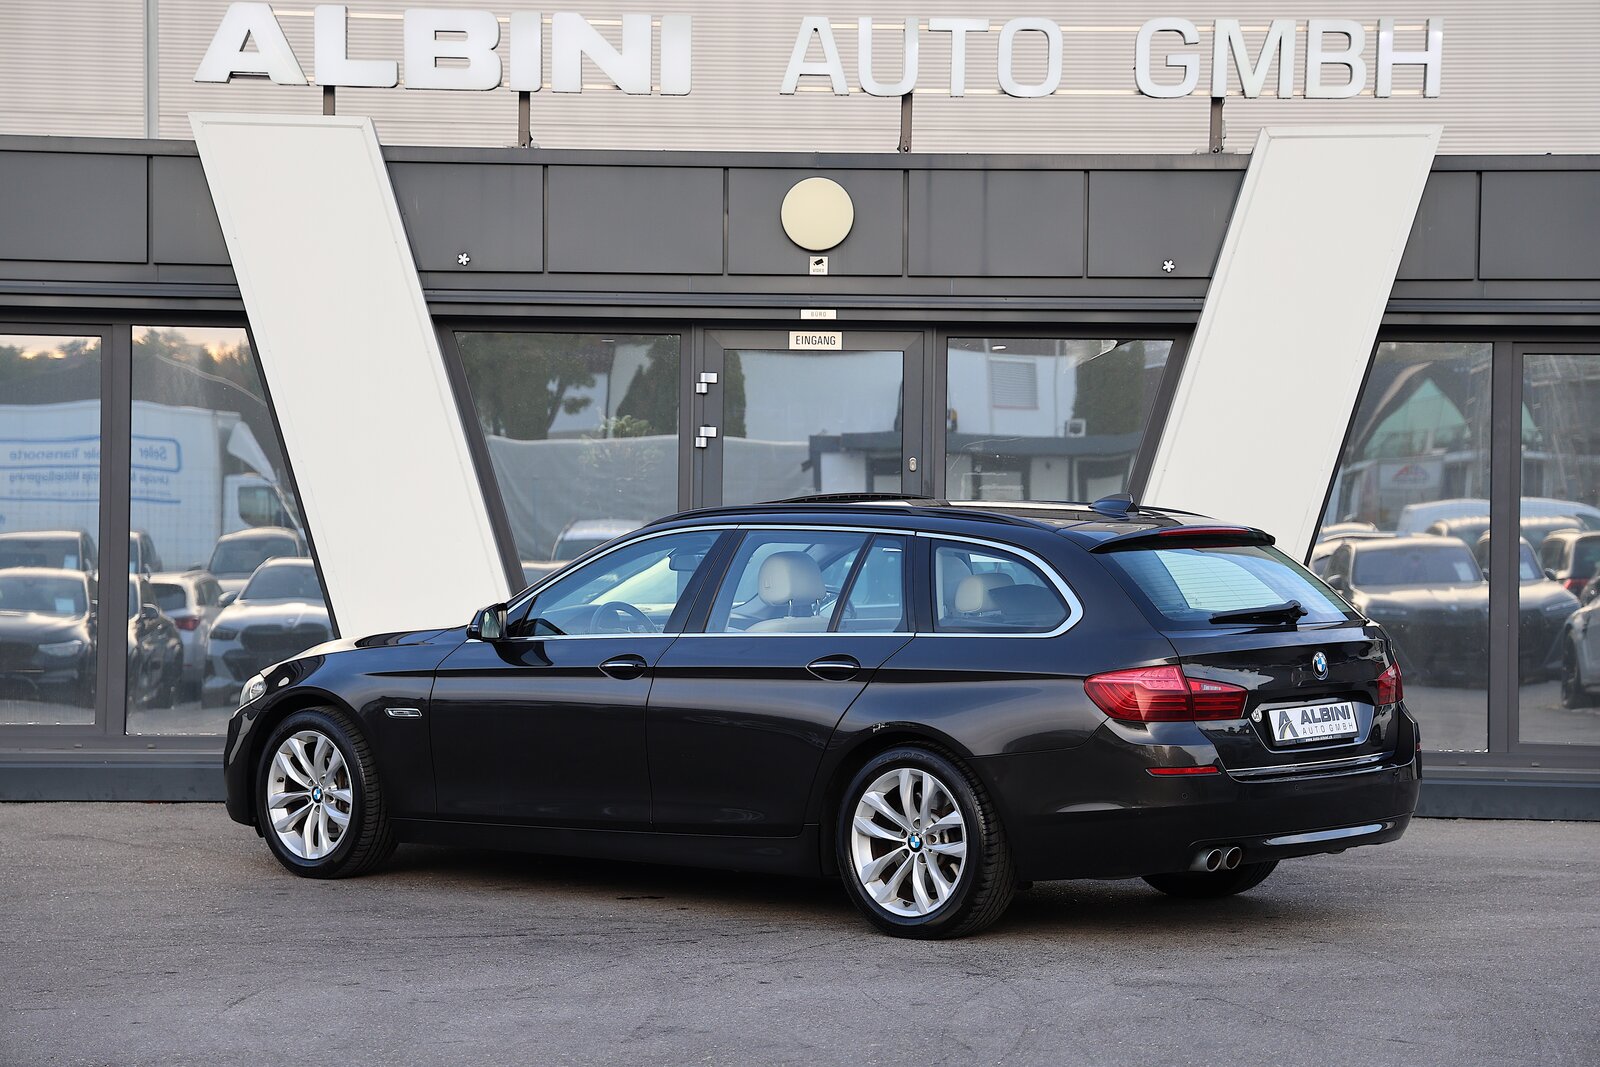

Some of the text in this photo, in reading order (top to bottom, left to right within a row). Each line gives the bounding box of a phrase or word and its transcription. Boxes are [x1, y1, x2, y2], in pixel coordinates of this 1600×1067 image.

[194, 2, 1444, 99] ALBINI AUTO GMBH
[795, 335, 836, 346] EINGANG
[1301, 705, 1351, 725] ALBINI
[1302, 722, 1354, 735] AUTO GMBH
